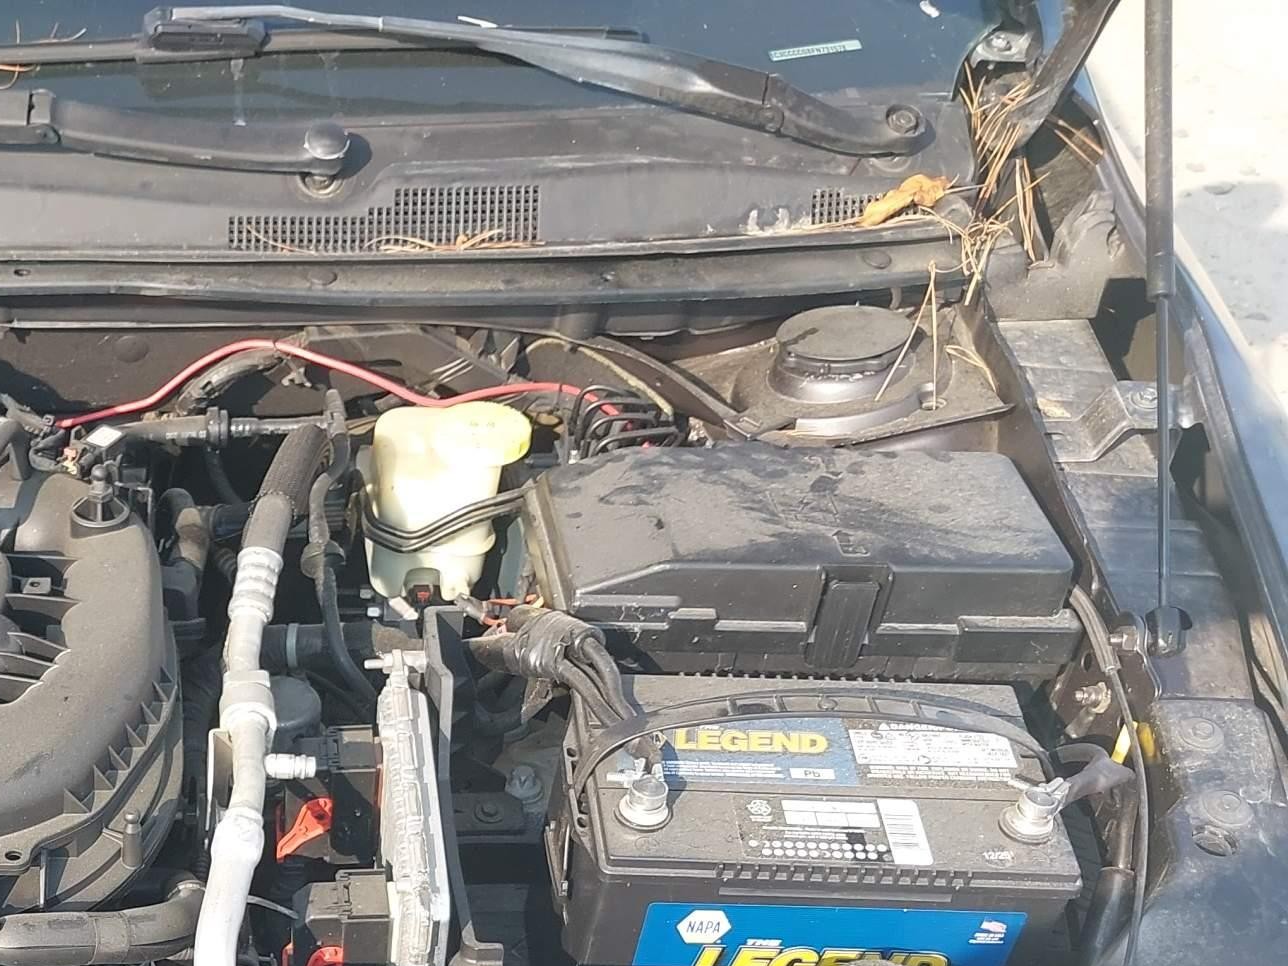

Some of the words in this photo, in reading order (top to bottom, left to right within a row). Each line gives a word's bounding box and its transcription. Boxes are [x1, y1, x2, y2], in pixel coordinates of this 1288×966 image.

[674, 728, 829, 753] LEGEND
[803, 769, 821, 778] Pb
[685, 919, 721, 934] NAPA
[745, 938, 783, 947] THE
